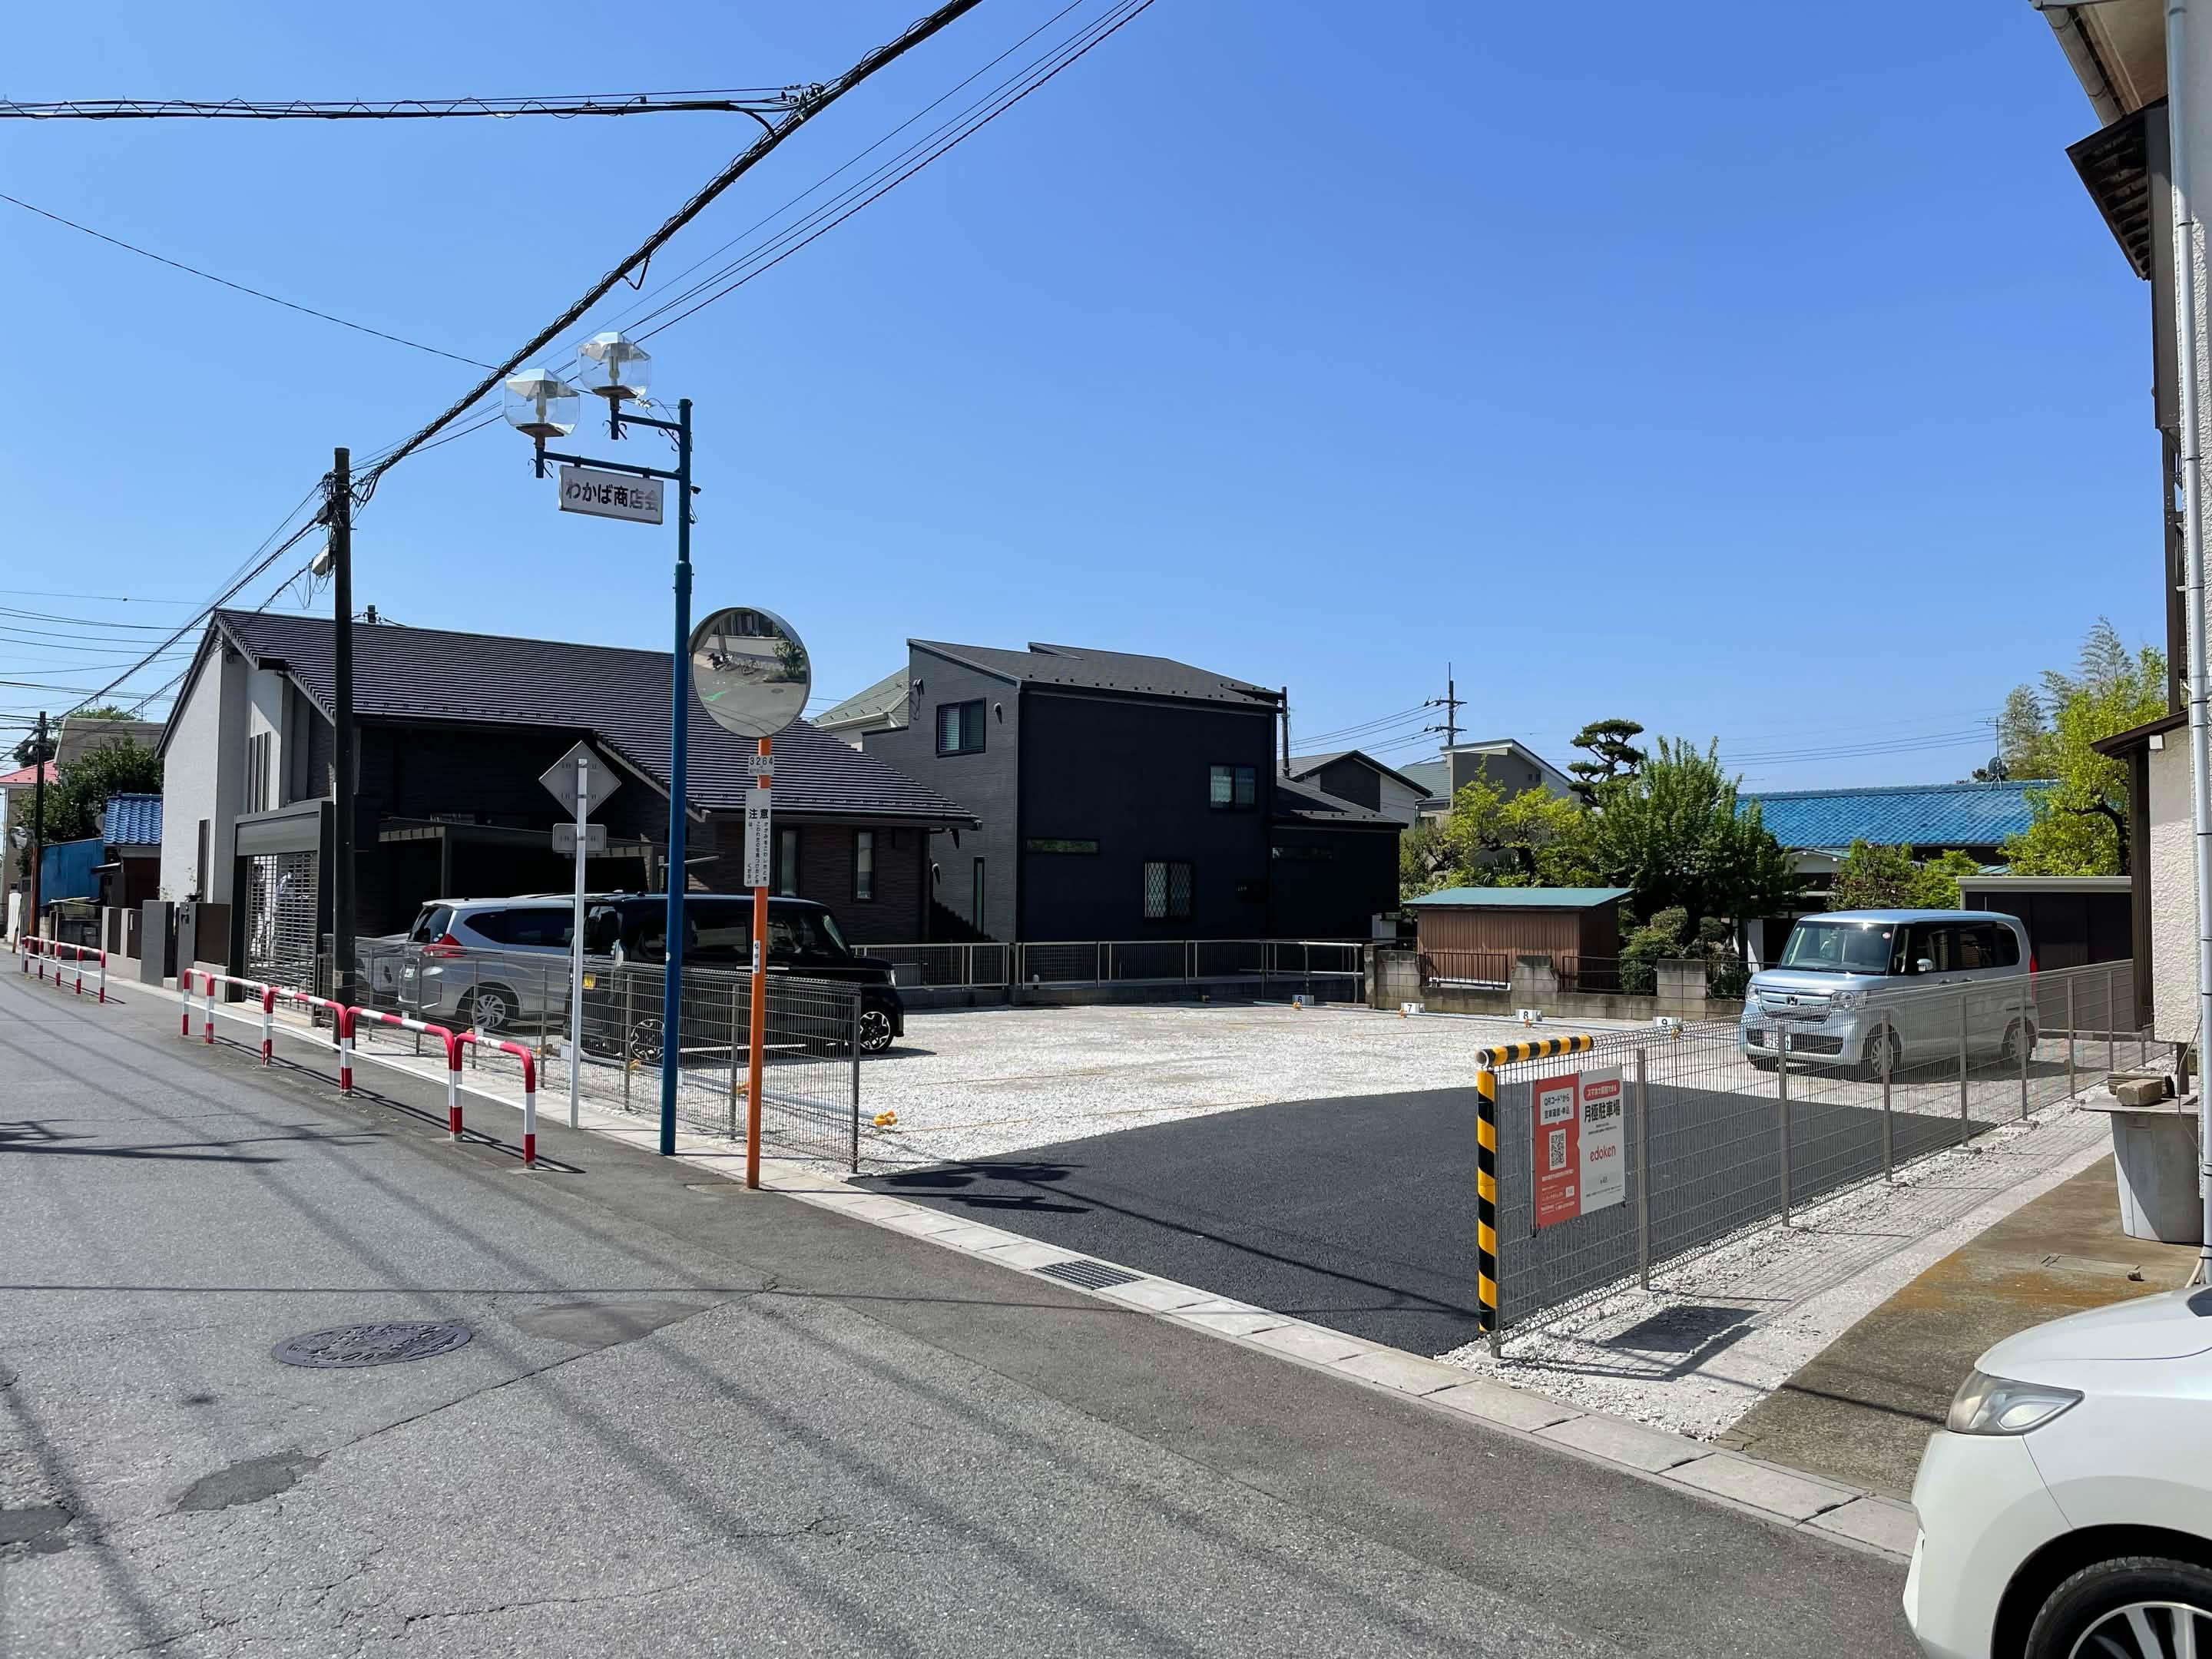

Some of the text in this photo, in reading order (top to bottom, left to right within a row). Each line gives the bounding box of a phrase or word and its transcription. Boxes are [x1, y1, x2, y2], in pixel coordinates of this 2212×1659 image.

[565, 479, 658, 512] わかば商店会
[750, 757, 773, 766] 3264
[749, 808, 769, 820] 注意
[1407, 1004, 1412, 1012] 7
[1523, 1011, 1528, 1020] 8
[1661, 1018, 1668, 1028] 9
[1584, 1099, 1621, 1123] 月極駐車場
[1590, 1144, 1616, 1162] edoken
